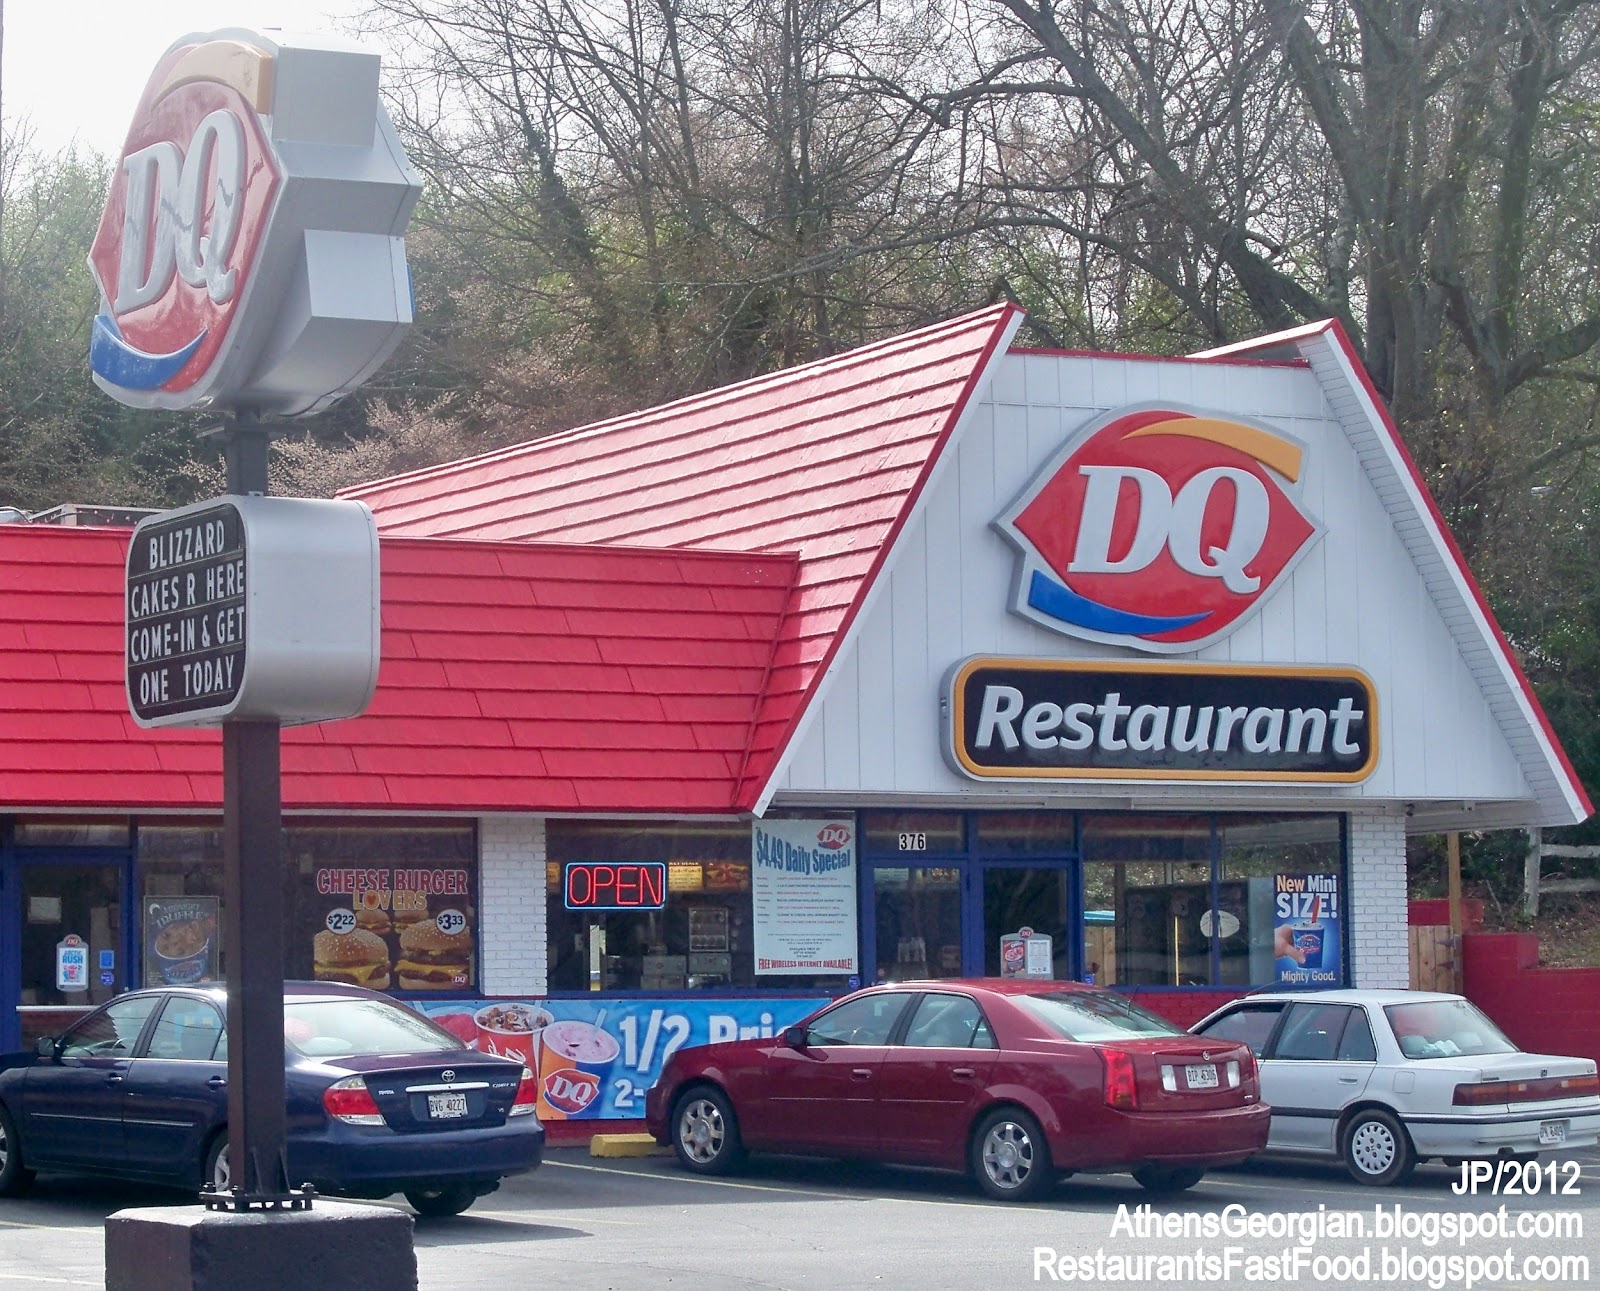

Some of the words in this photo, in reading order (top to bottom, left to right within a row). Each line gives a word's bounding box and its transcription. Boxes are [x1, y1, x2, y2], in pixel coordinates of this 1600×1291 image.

[114, 108, 249, 306] DQ
[150, 520, 225, 570] BLIZZARD
[1068, 465, 1270, 595] DQ
[131, 576, 179, 617] CAKES
[187, 573, 195, 605] R
[206, 560, 244, 601] HERE
[131, 618, 195, 662] COME-IN
[202, 615, 211, 647] &
[217, 608, 244, 644] GET
[140, 669, 169, 705] ONE
[183, 655, 234, 697] TODAY
[975, 686, 1364, 755] Restaurant
[756, 828, 783, 870] $4.49
[785, 842, 810, 875] Daily
[813, 849, 851, 874] Special
[822, 828, 849, 845] DQ
[900, 834, 925, 850] 376
[317, 869, 389, 894] CHEESE
[394, 869, 468, 895] BURGER
[569, 867, 662, 904] OPEN
[1277, 875, 1305, 892] New
[1308, 874, 1337, 893] Mini
[353, 890, 427, 910] LOVERS
[1277, 893, 1337, 919] SIZE!
[63, 956, 83, 964] RUSH
[758, 958, 771, 970] FREE
[771, 959, 797, 969] WIRELESS
[798, 960, 822, 968] INTERNET
[823, 958, 853, 970] AVAILABLE!
[1281, 971, 1309, 983] Mighty
[1312, 971, 1336, 981] Good.
[619, 1010, 690, 1071] 1/2
[551, 1075, 592, 1105] DQ
